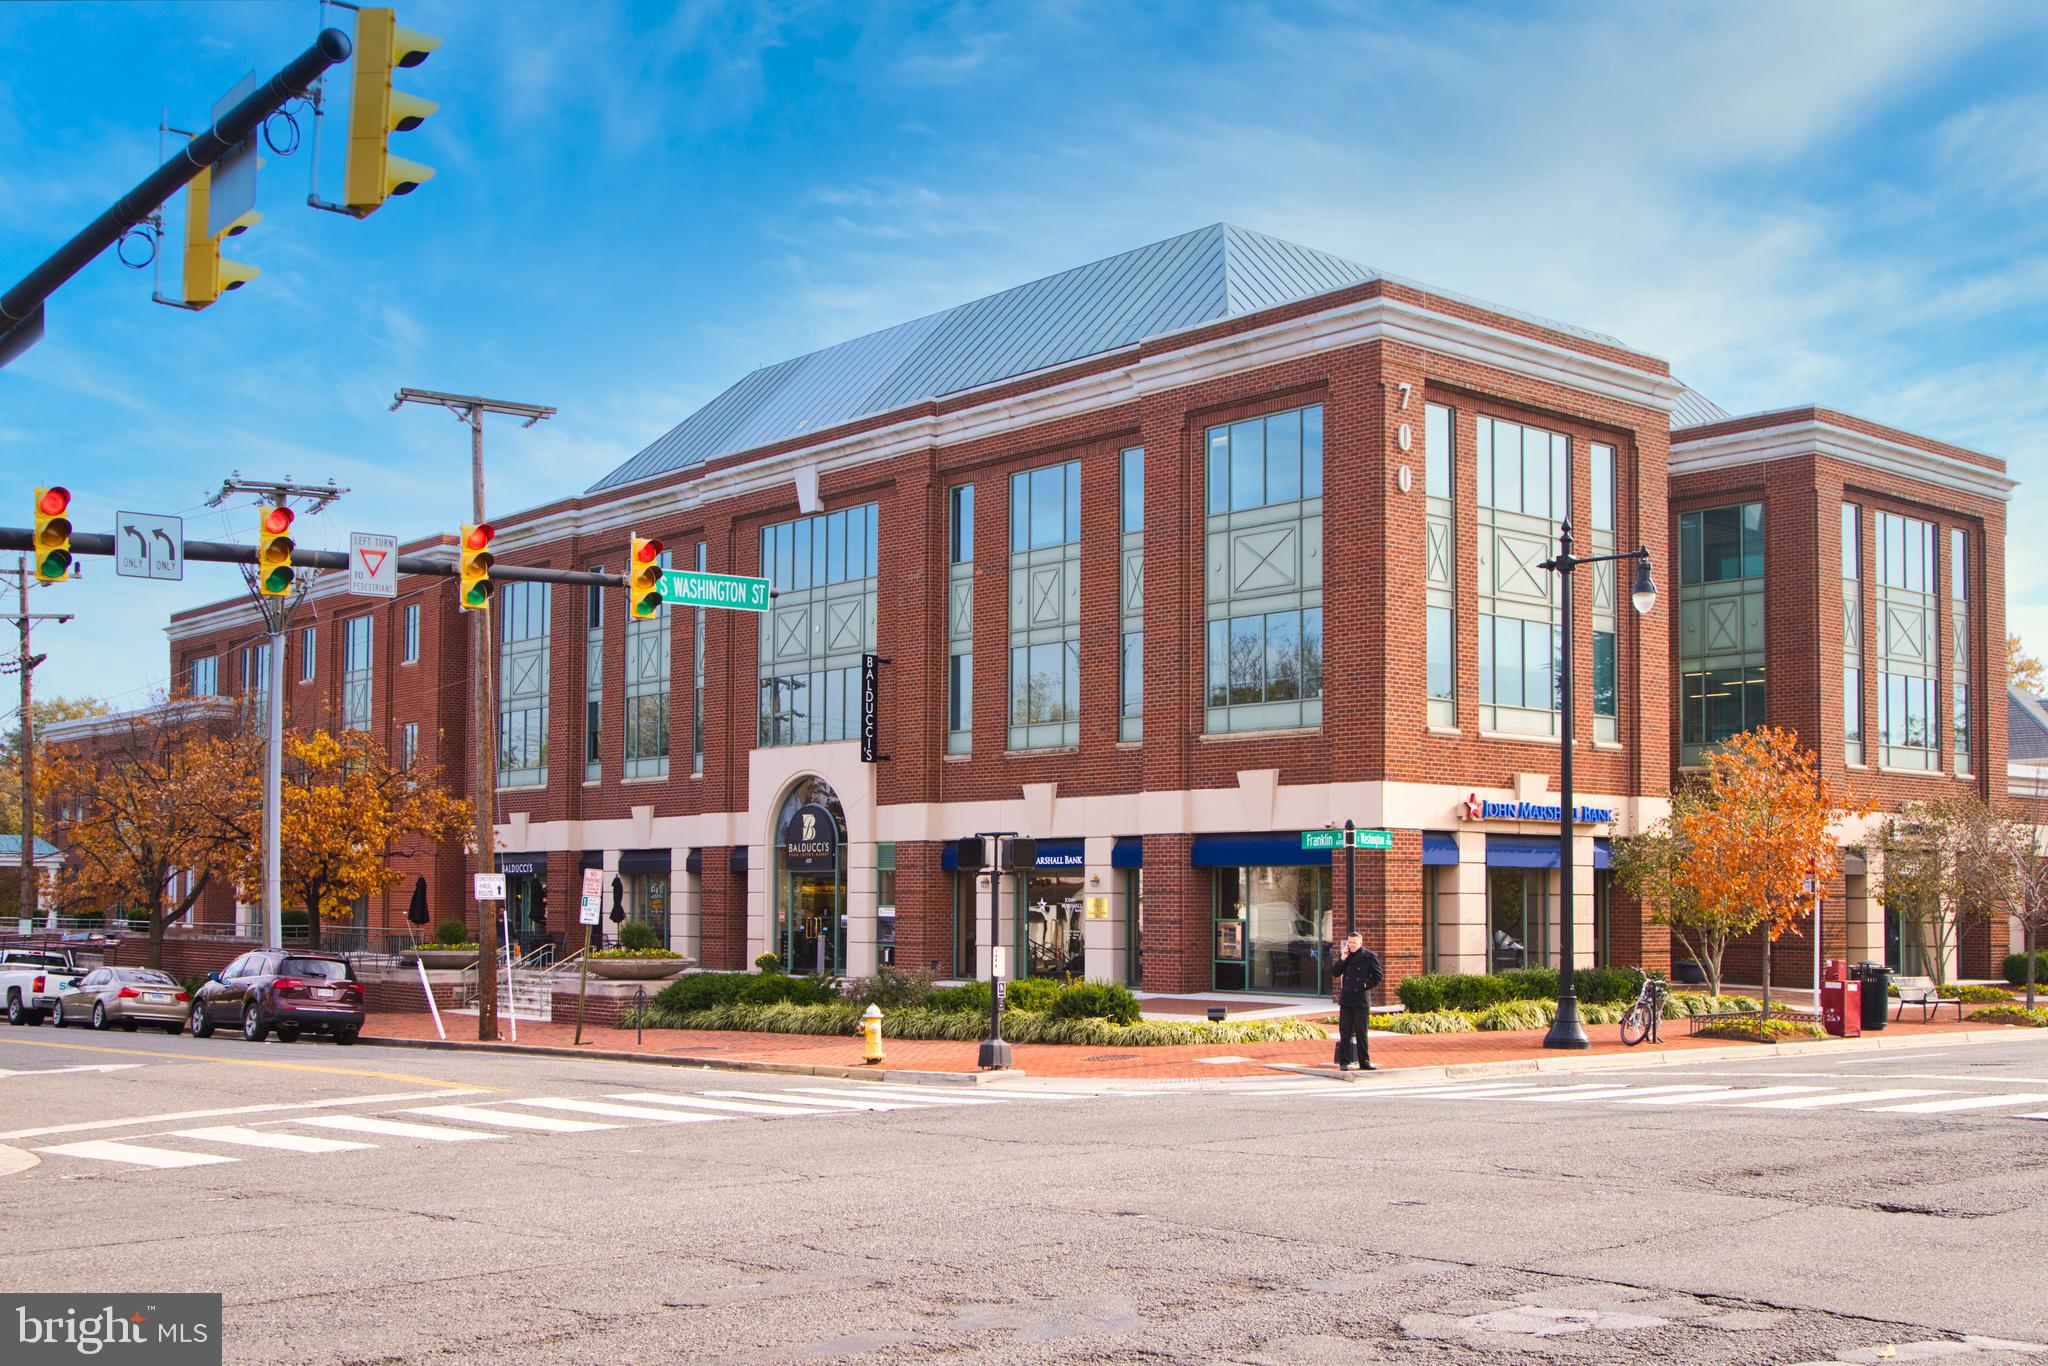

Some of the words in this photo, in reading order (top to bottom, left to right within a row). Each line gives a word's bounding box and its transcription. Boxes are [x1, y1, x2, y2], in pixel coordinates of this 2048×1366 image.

[1398, 382, 1412, 492] 700
[354, 536, 371, 546] LEFT
[375, 537, 394, 548] TURN
[123, 557, 143, 568] ONLY
[157, 561, 176, 570] ONLY
[355, 571, 363, 579] TO
[353, 583, 392, 593] PEDESTRIANS
[660, 575, 668, 596] S
[673, 577, 746, 602] WASHINGTON
[752, 584, 766, 604] ST
[864, 656, 874, 761] BALDUCCI'S
[1482, 800, 1517, 818] JOHN
[1582, 806, 1614, 822] BANK
[1306, 834, 1333, 846] Franklin
[1361, 832, 1384, 848] Washington
[788, 843, 829, 852] BALDUCCI'S
[1064, 856, 1083, 864] BANK
[502, 864, 533, 873] BALDUCCI'S
